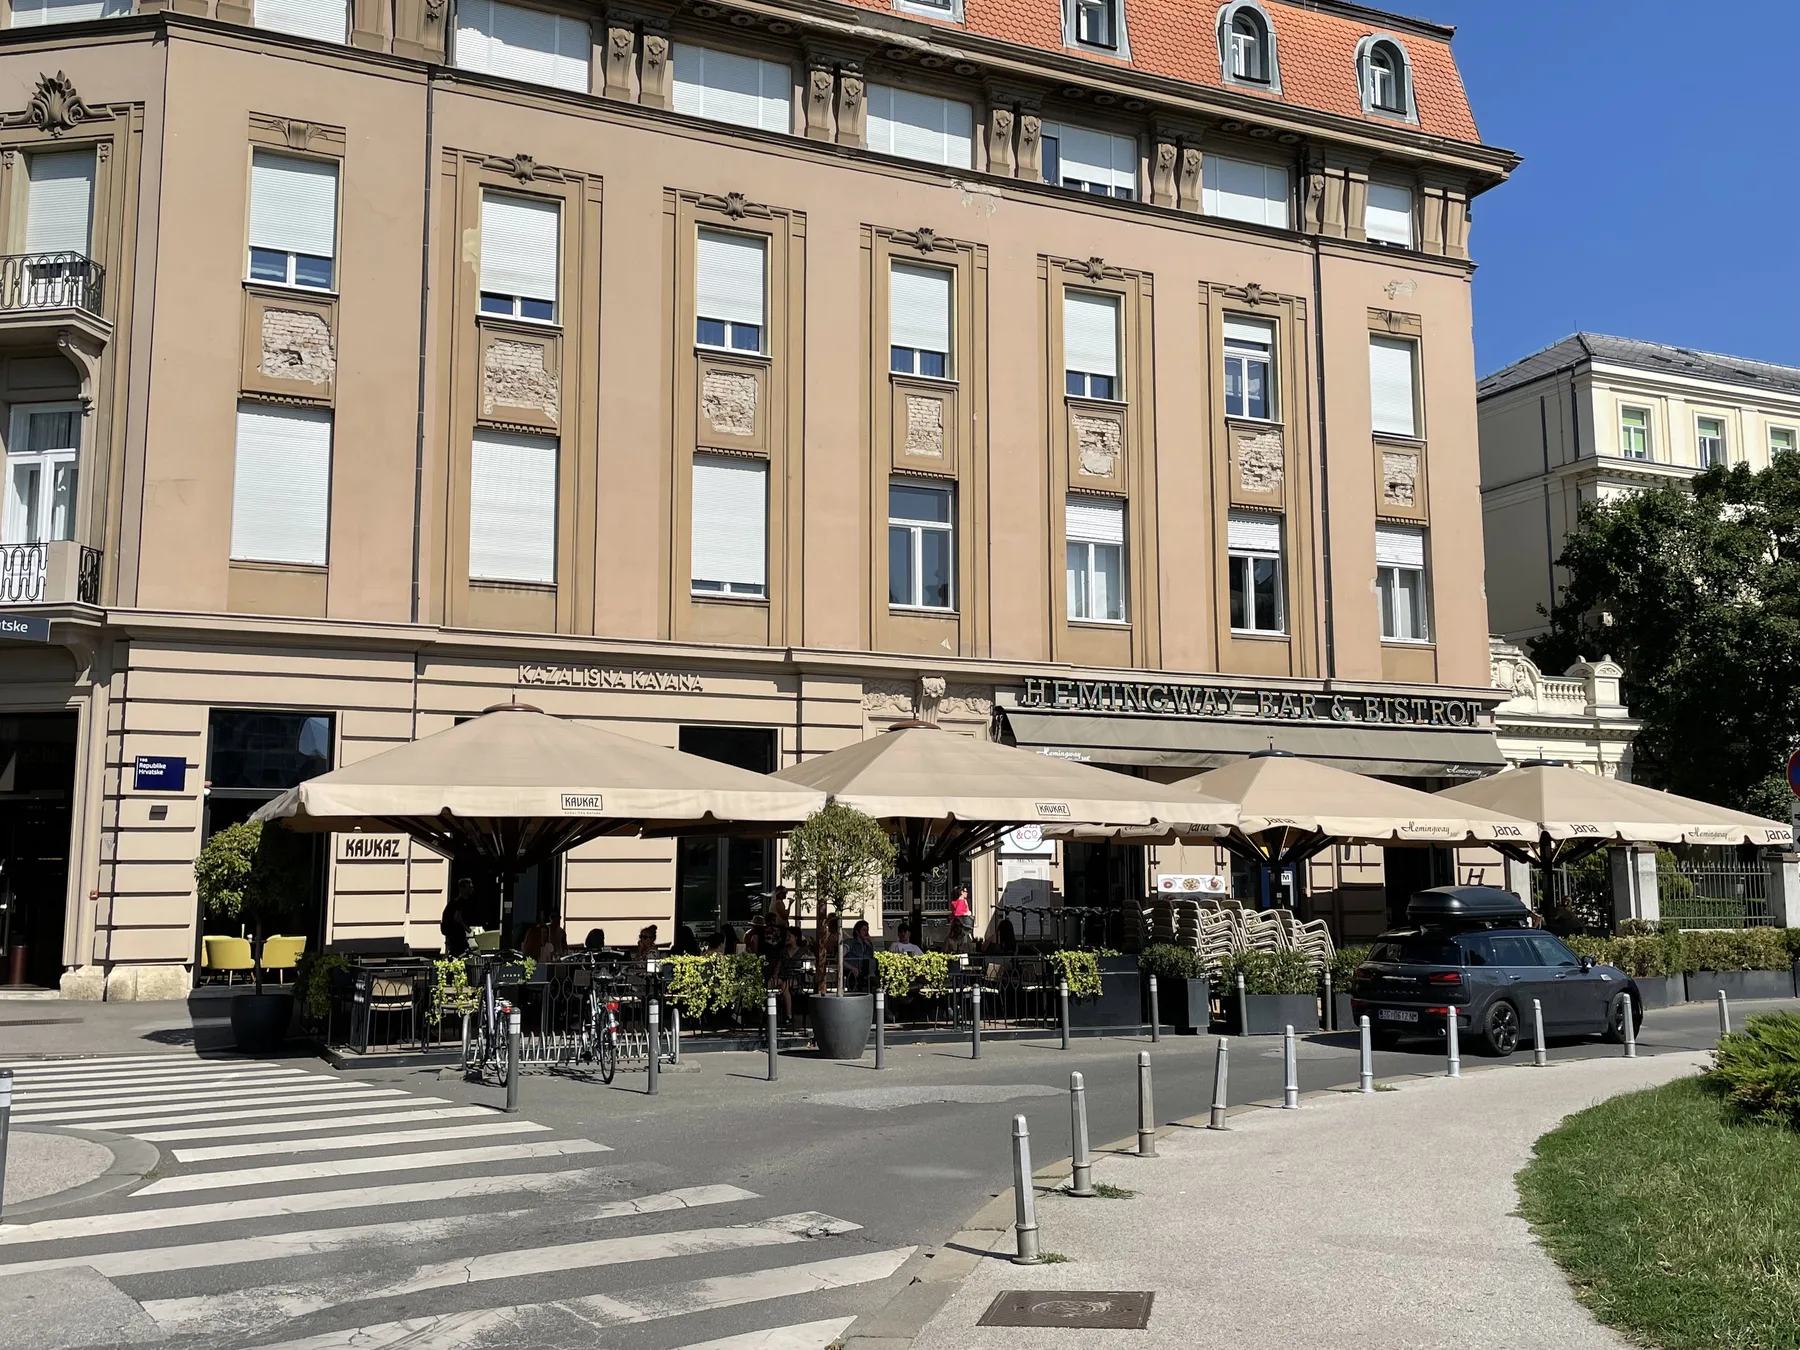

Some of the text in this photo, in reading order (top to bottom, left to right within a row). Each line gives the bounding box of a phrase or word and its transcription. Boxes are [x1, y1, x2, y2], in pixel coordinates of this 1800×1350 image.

[0, 620, 28, 633] tske
[631, 670, 704, 692] KAVANA
[1023, 678, 1482, 727] HEMINGWAY BAR & BISTROT
[565, 797, 599, 807] KAVKAZ
[1039, 805, 1067, 813] KAVKAZ
[1401, 821, 1450, 834] Hemingway
[345, 838, 400, 857] KAVKAZ
